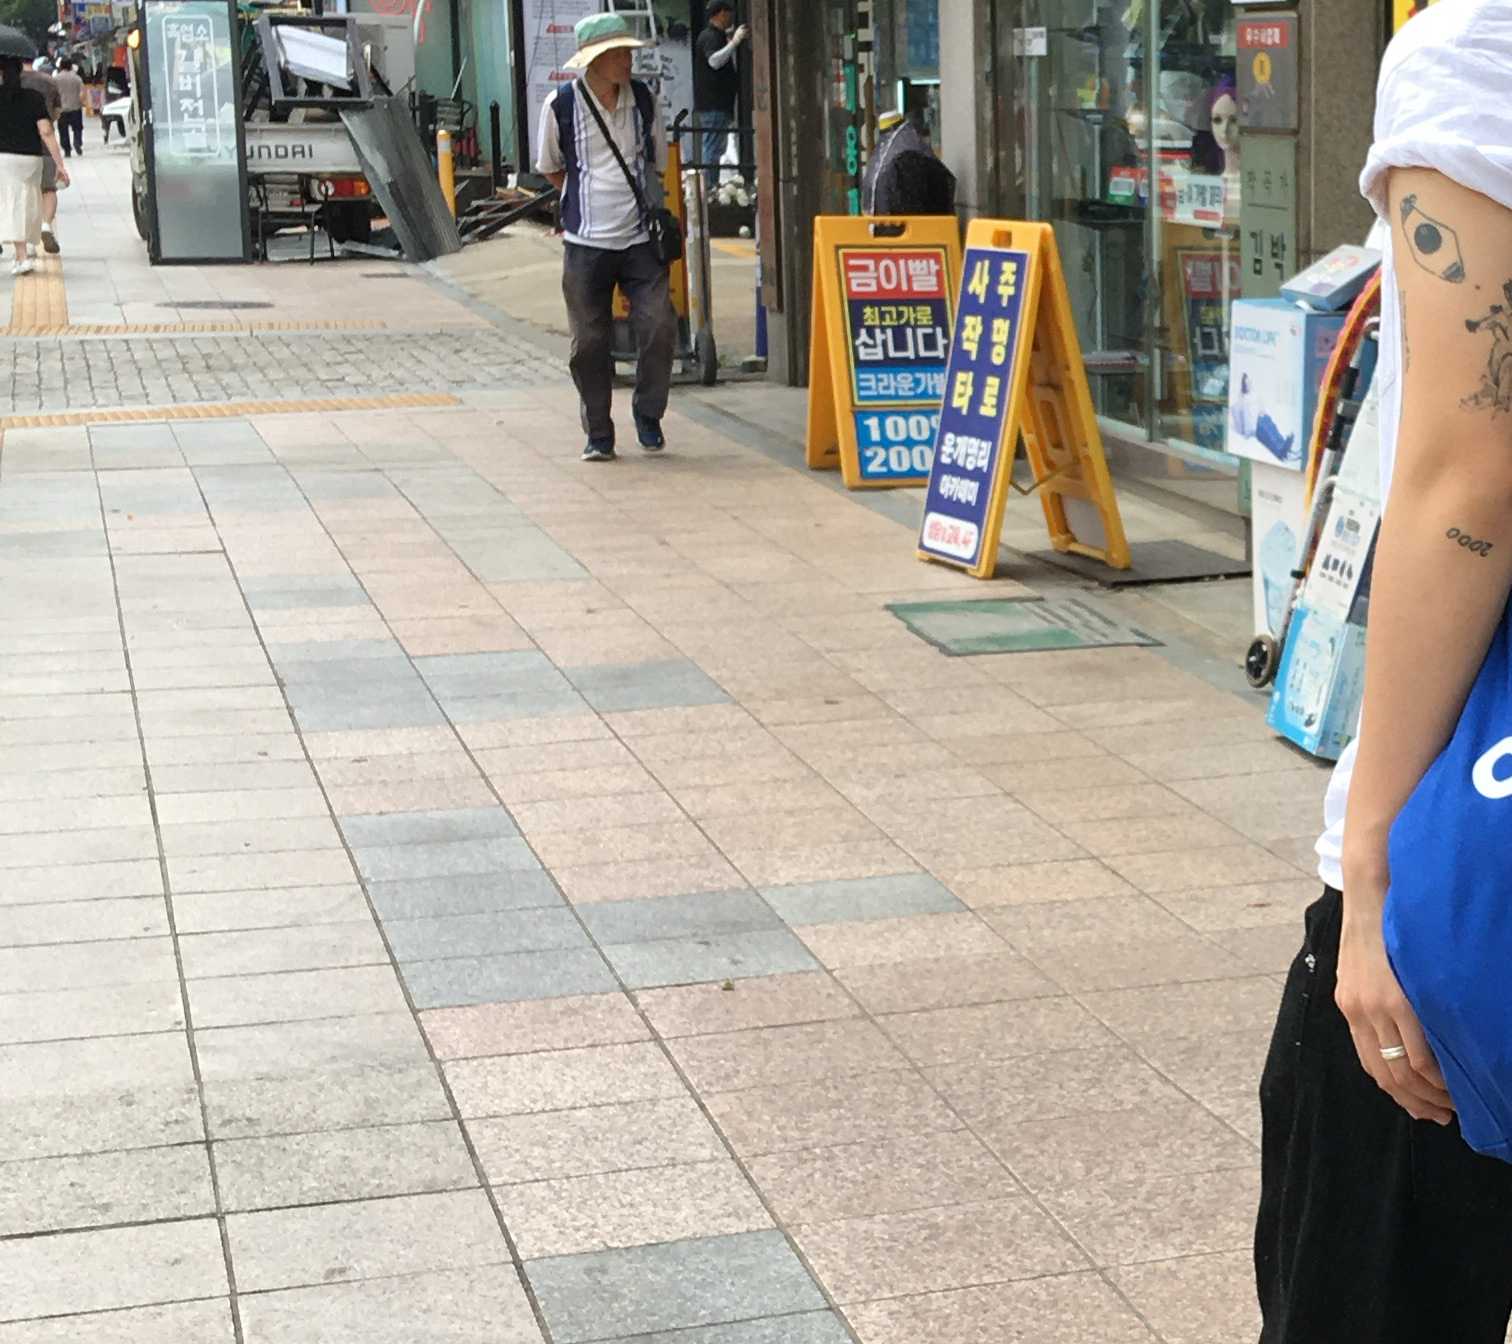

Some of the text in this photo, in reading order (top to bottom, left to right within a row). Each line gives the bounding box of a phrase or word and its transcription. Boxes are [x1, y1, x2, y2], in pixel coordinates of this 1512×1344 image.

[847, 258, 940, 293] 금이빨
[863, 306, 932, 326] 최고가로
[855, 328, 948, 360] 삽니다
